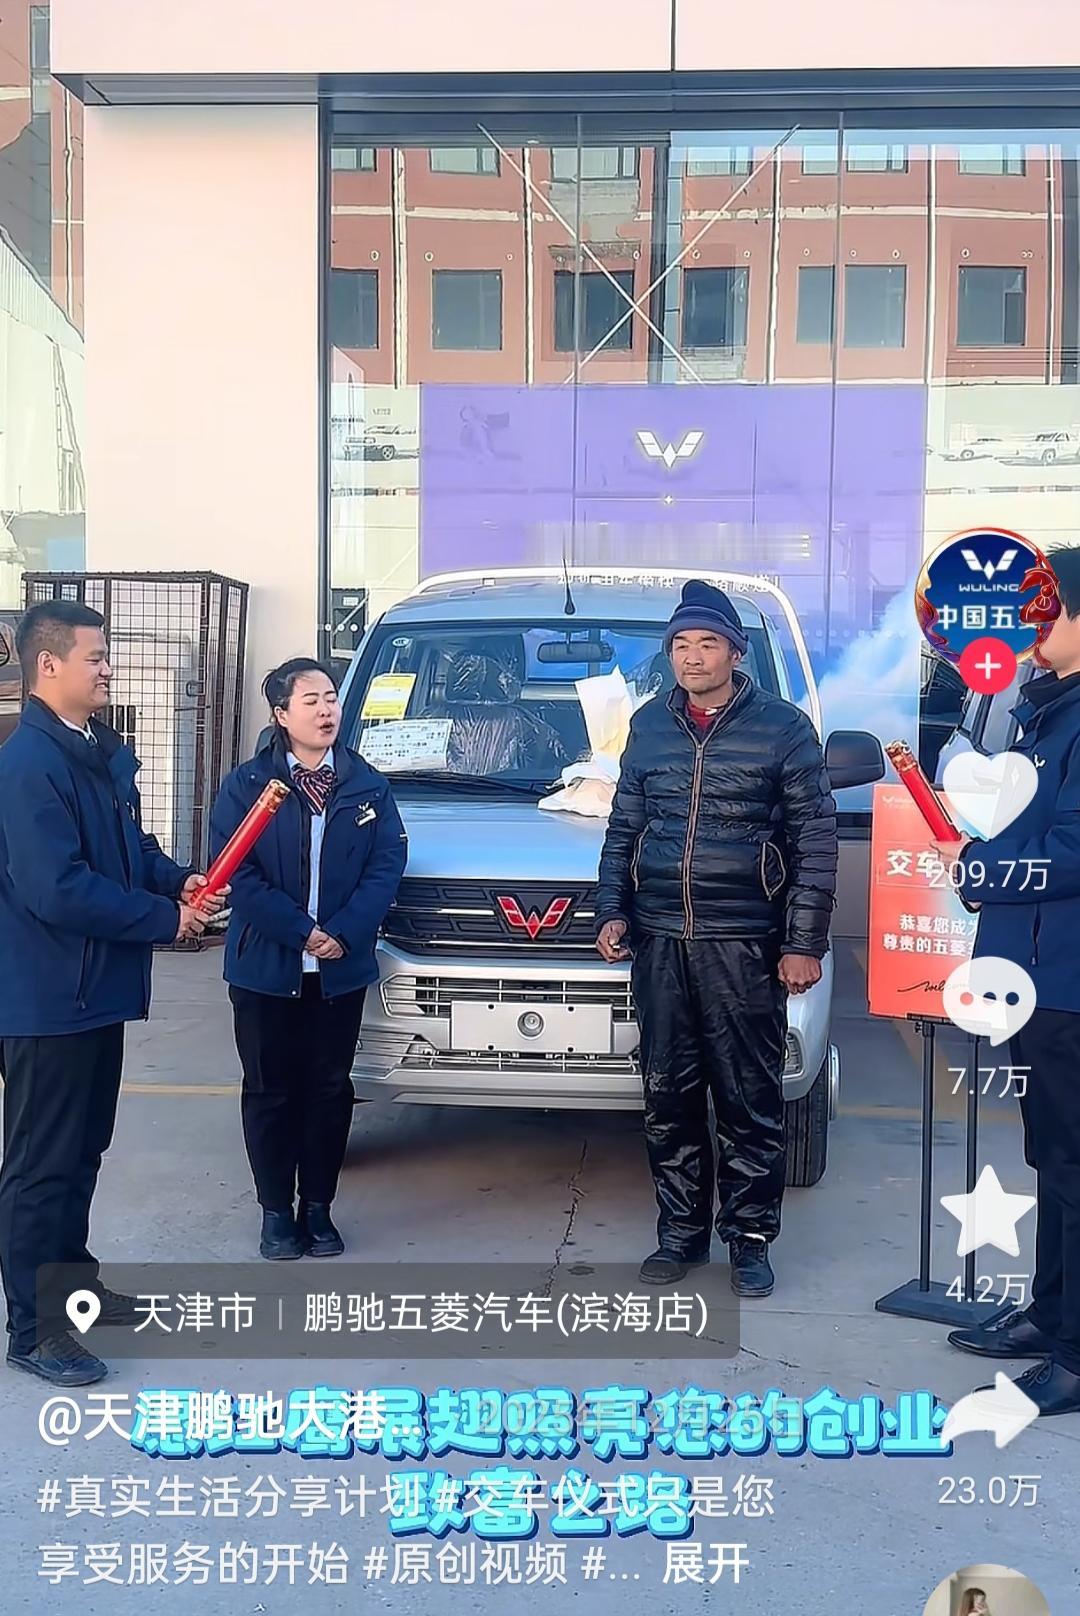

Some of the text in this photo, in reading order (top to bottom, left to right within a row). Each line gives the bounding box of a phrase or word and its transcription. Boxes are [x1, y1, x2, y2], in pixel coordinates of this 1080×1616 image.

[883, 932, 974, 957] 尊贵的五菱
